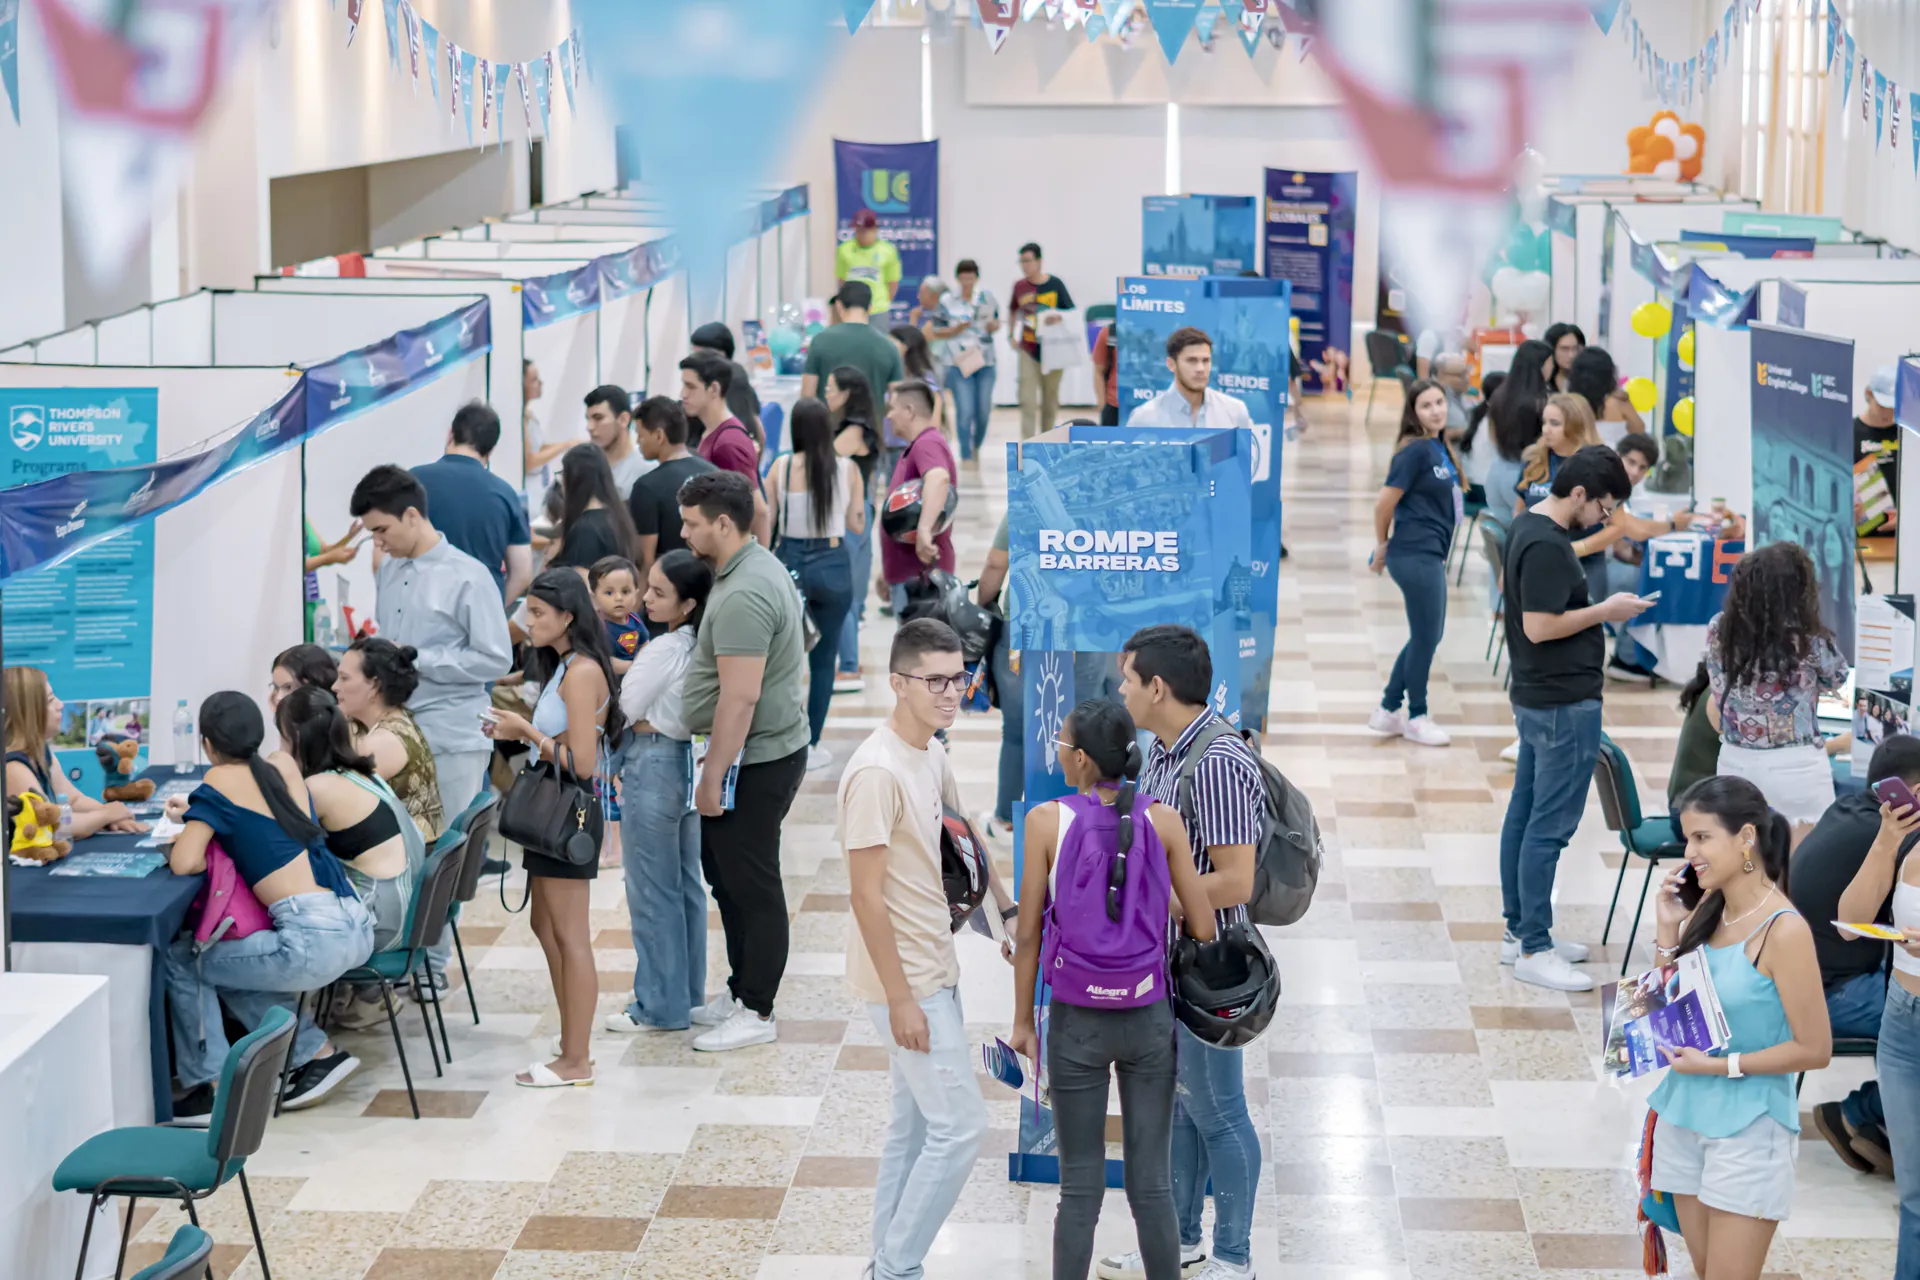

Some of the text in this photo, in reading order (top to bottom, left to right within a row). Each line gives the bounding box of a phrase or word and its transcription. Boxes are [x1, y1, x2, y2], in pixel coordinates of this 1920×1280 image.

[49, 408, 121, 420] THOMPSON
[48, 421, 95, 433] RIVERS
[48, 434, 123, 446] UNIVERSITY
[12, 459, 88, 476] Programs
[1039, 529, 1179, 554] ROMPE
[1039, 555, 1180, 572] BARRERAS
[1086, 984, 1128, 997] Allegra
